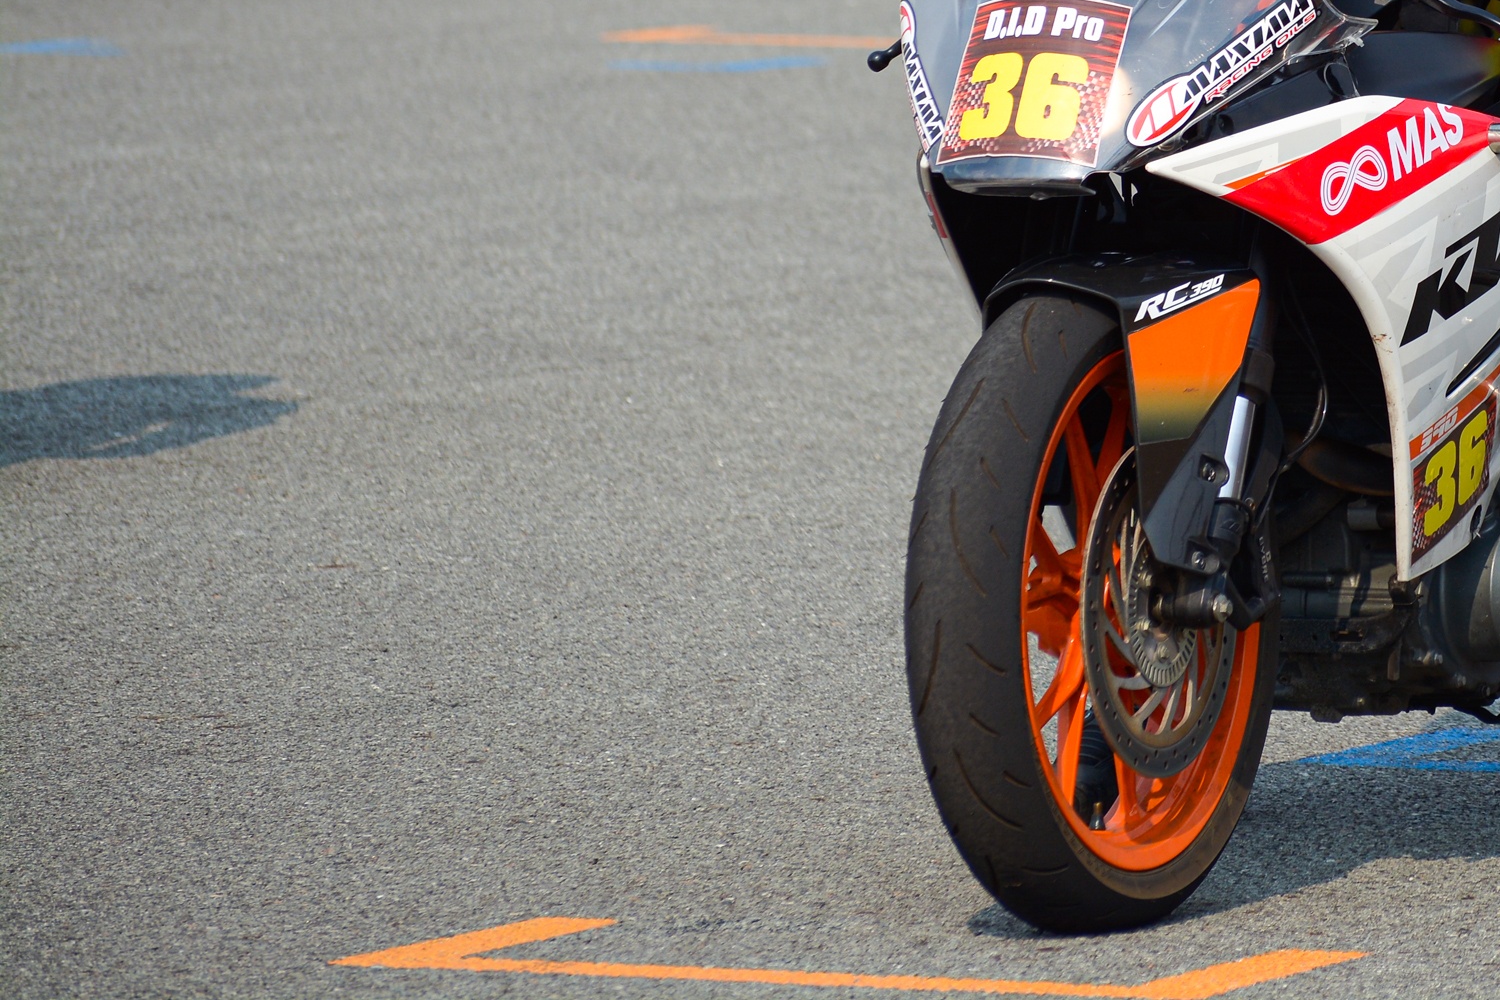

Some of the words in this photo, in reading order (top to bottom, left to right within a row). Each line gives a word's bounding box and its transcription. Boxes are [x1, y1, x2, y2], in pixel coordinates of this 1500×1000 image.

[983, 5, 1047, 40] D.I.D
[1050, 6, 1105, 41] Pro
[1275, 10, 1317, 48] OILS
[959, 52, 1090, 141] 36
[1386, 102, 1464, 182] MAS
[1133, 281, 1192, 323] RC
[1189, 273, 1225, 299] 390
[1423, 409, 1488, 538] 36
